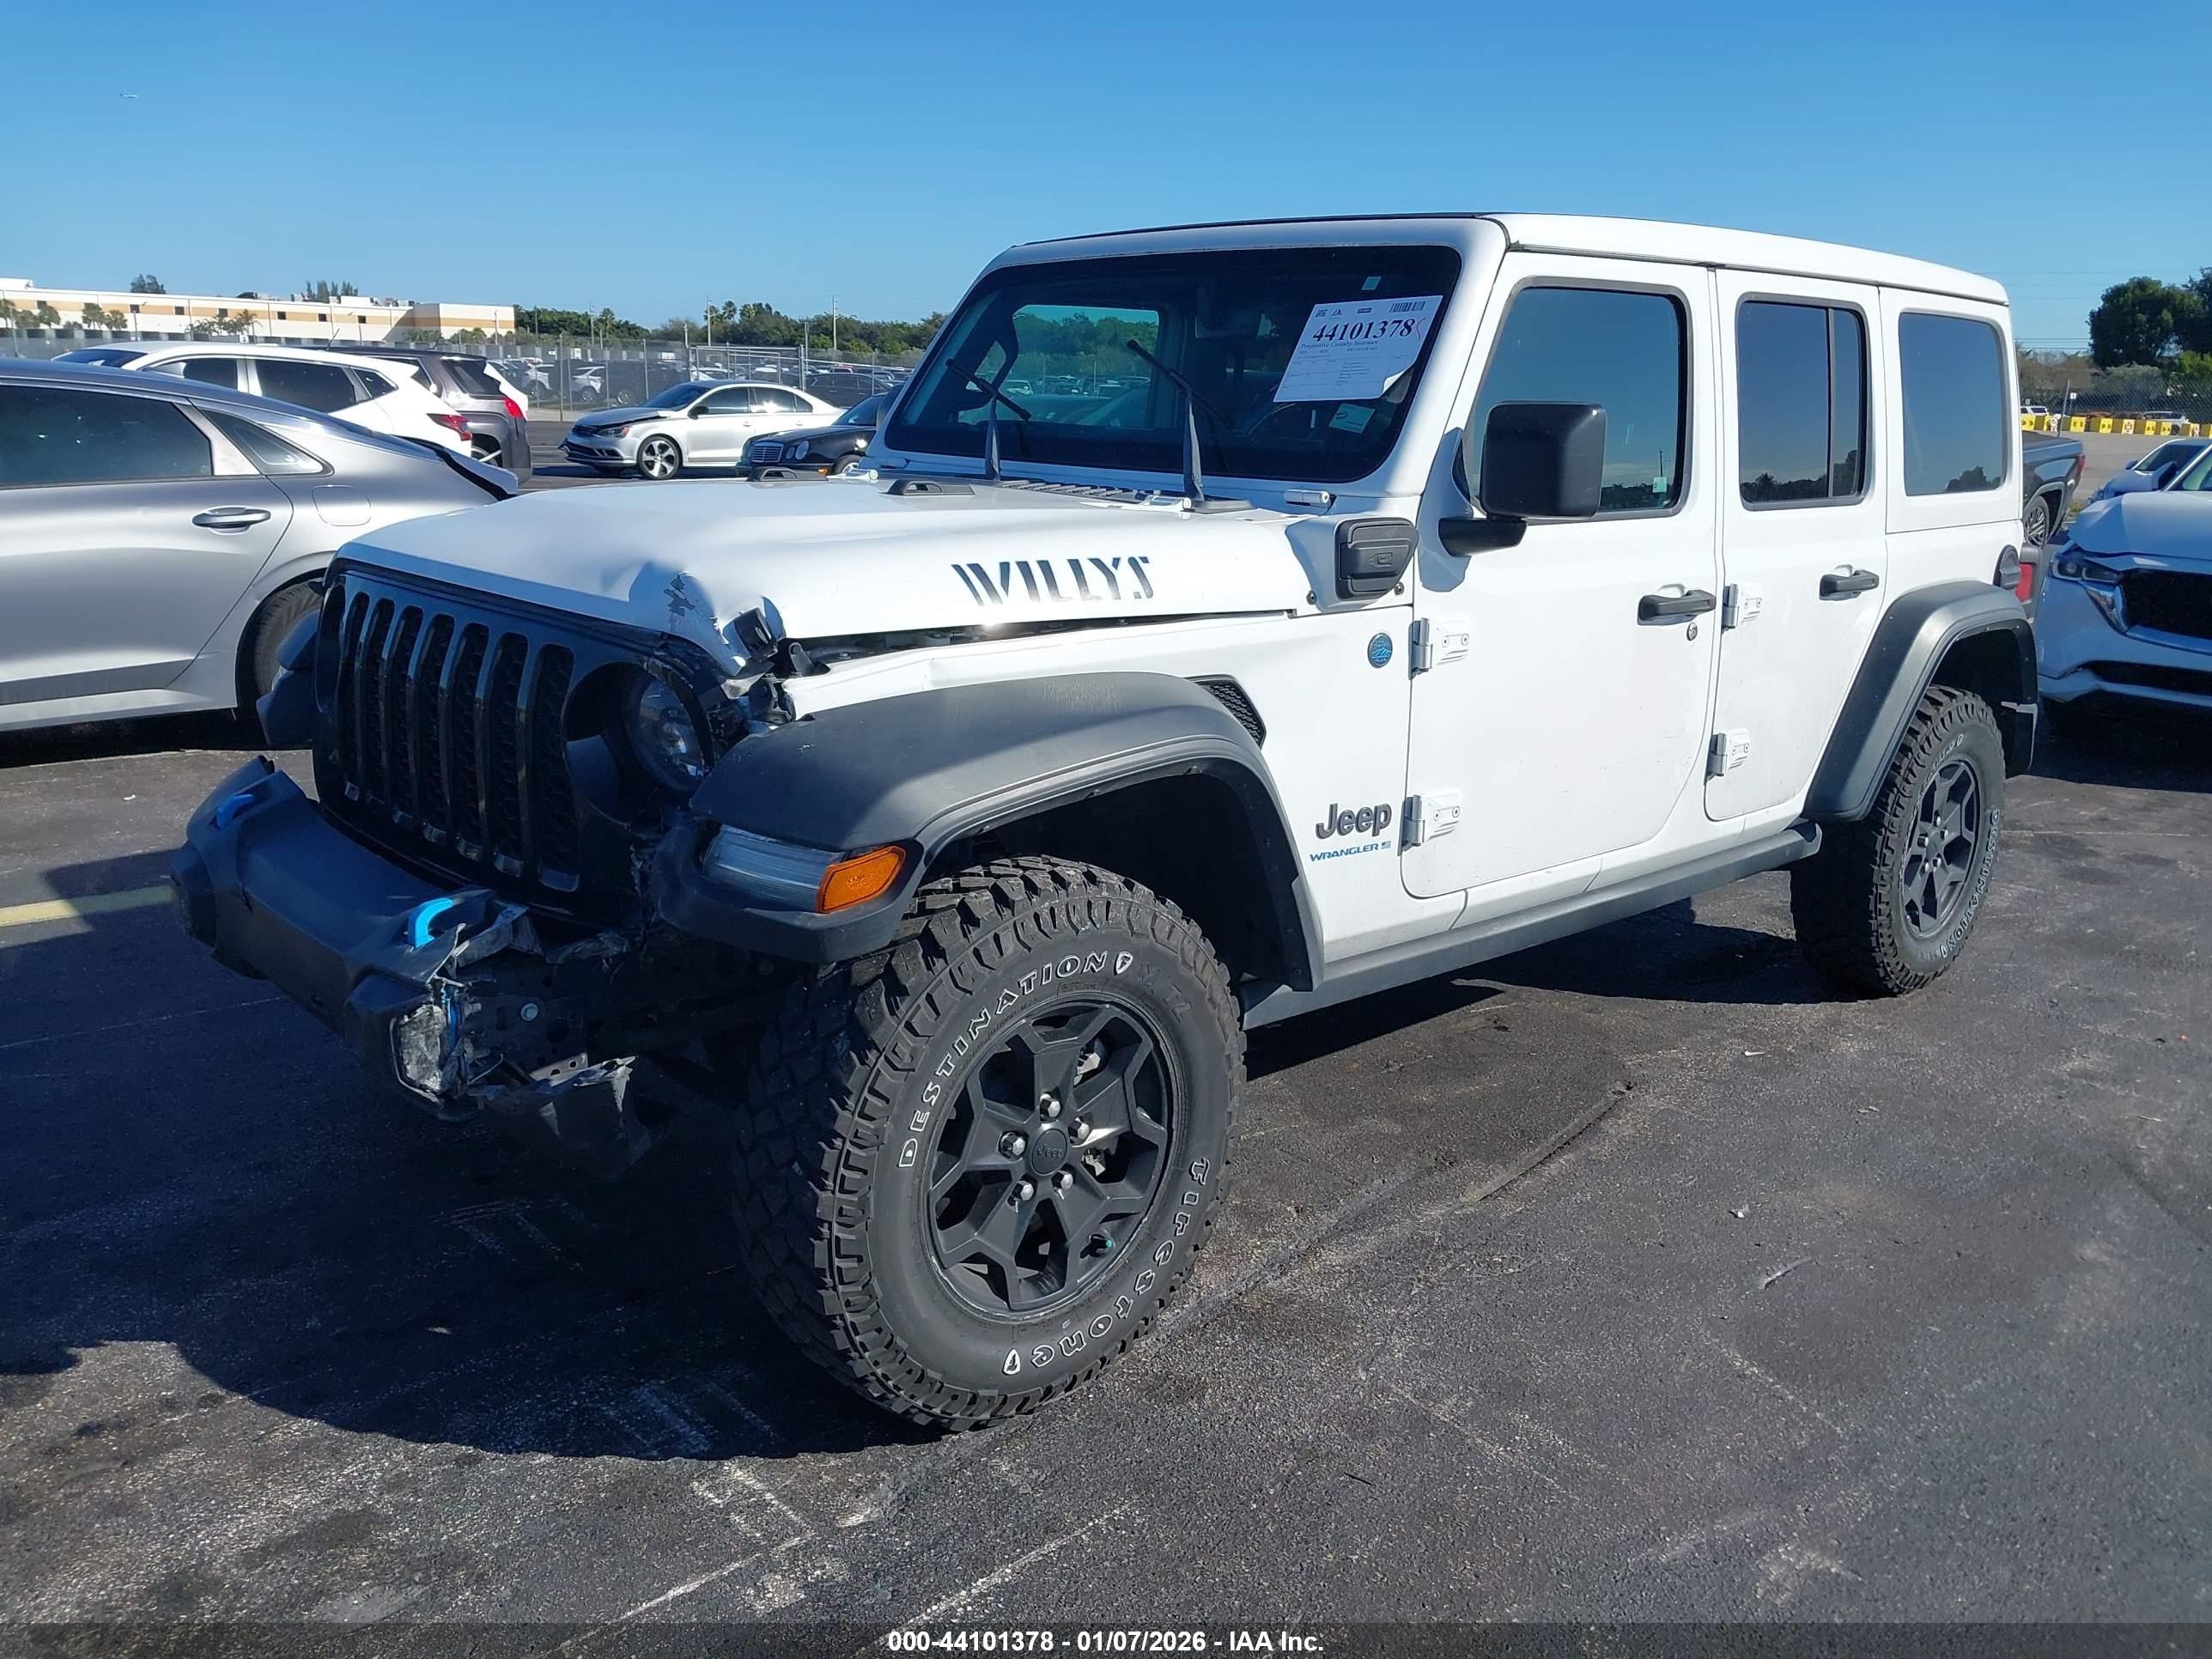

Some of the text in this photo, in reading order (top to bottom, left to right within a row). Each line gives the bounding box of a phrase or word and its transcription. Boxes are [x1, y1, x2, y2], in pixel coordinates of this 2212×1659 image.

[1312, 318, 1416, 342] 44101378
[951, 556, 1154, 605] WILLYS
[1315, 803, 1392, 839] Jeep
[1310, 842, 1379, 861] WRANGLER
[898, 951, 1109, 1168] DESTINATION
